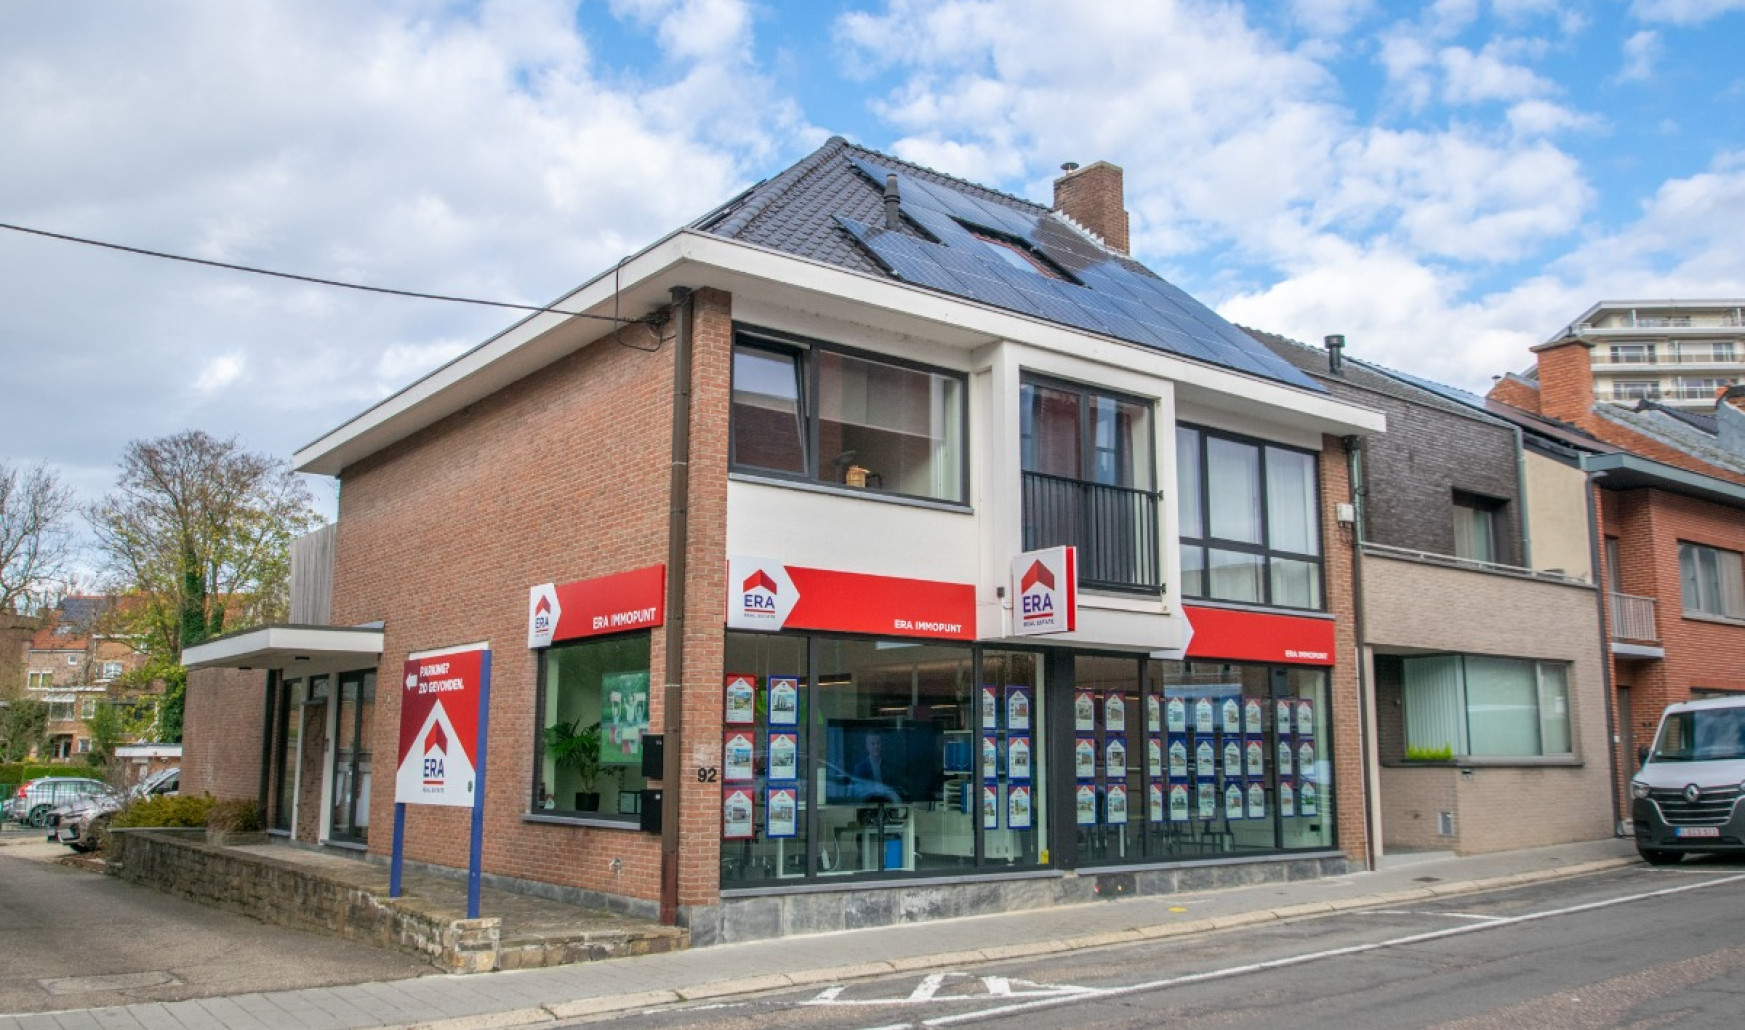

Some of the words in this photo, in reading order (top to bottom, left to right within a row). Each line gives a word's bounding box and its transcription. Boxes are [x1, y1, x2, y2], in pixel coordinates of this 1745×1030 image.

[744, 594, 775, 609] ERA
[1023, 593, 1053, 613] ERA
[535, 617, 549, 629] ERA
[592, 617, 608, 630] ERA
[611, 607, 656, 627] IMMOPUNT
[894, 619, 913, 630] ERA
[915, 621, 962, 633] IMMOPUNT
[420, 662, 450, 677] PARKING?
[428, 678, 464, 693] GEVONDEN.
[423, 758, 445, 778] ERA
[697, 767, 718, 783] 92
